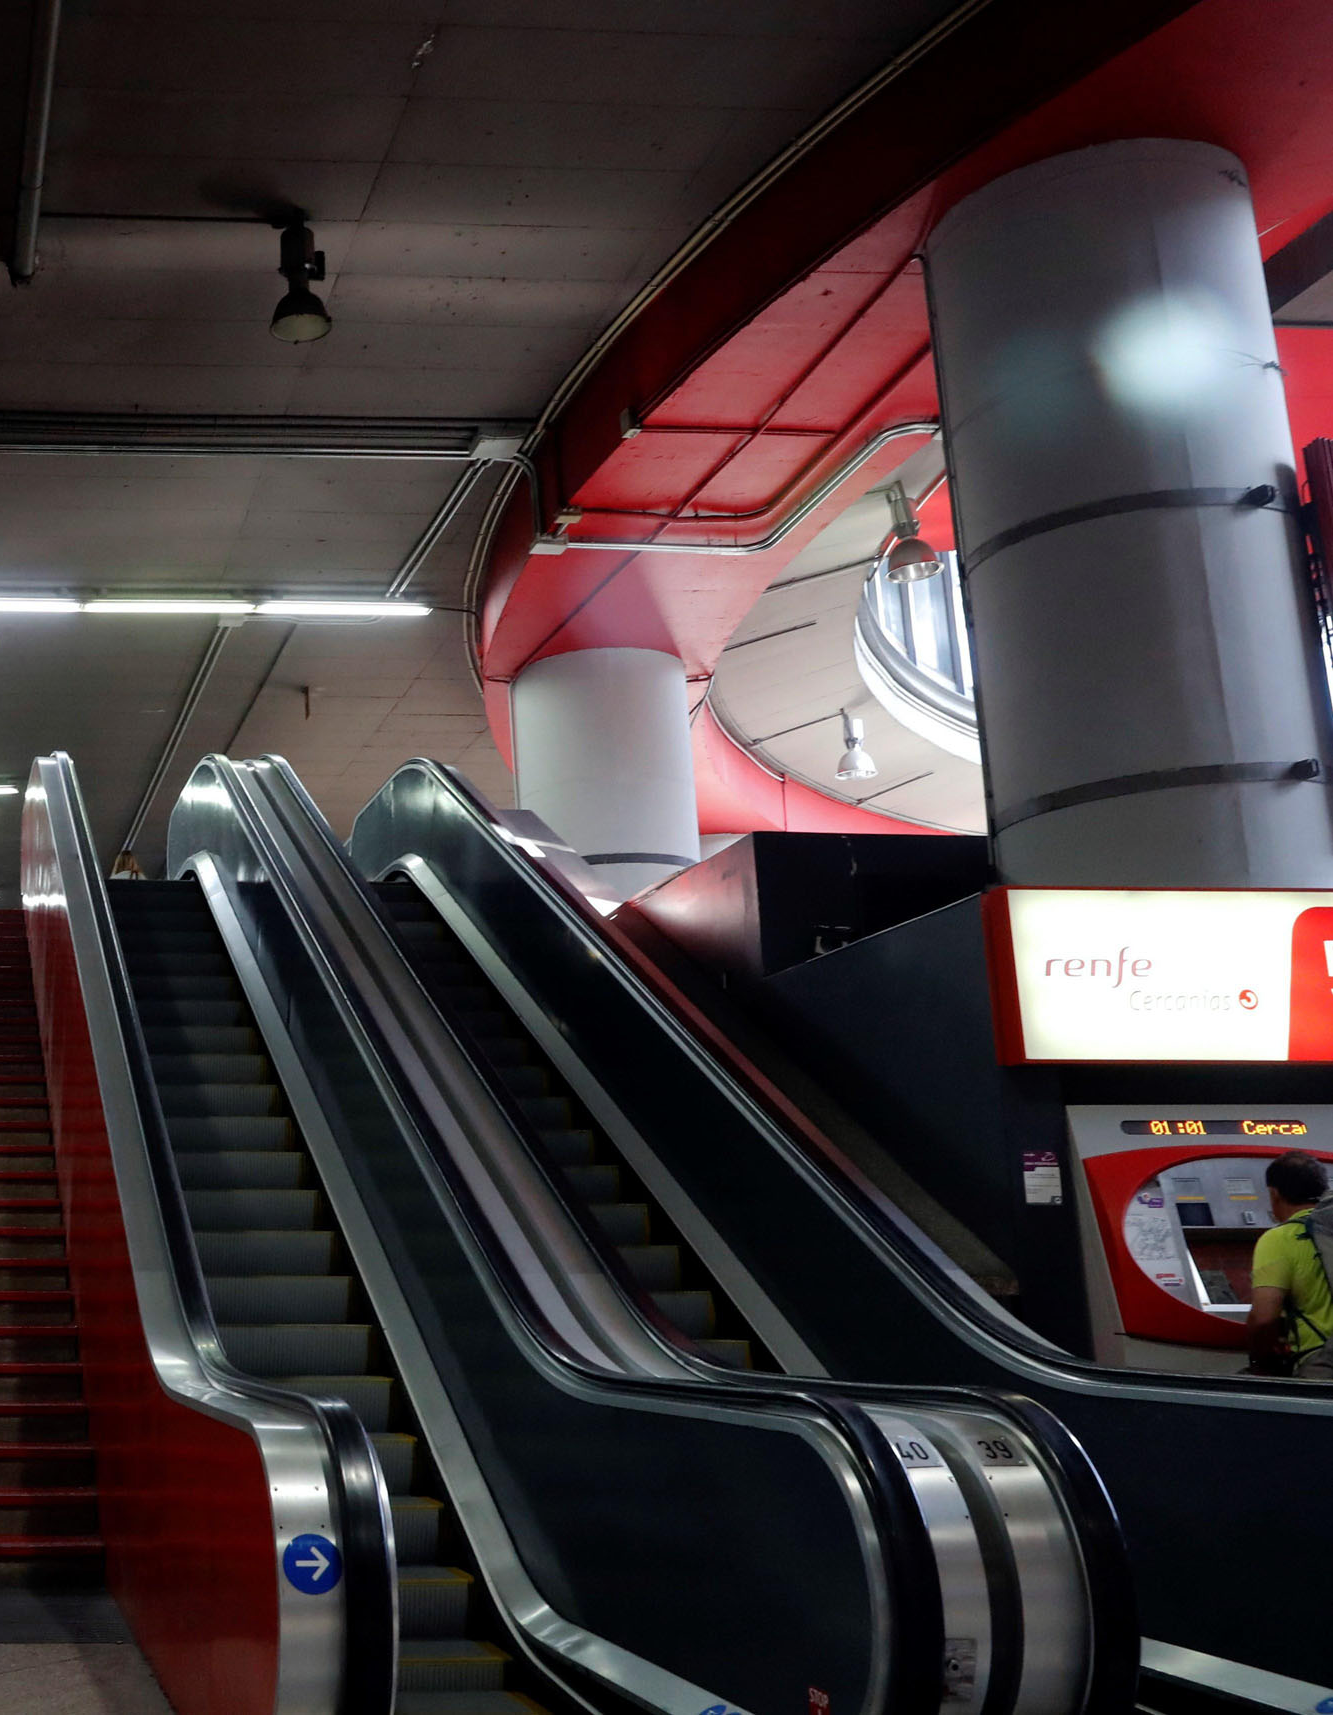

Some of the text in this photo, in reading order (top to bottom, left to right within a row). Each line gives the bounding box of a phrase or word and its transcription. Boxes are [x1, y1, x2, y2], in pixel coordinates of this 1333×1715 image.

[1045, 946, 1152, 988] renfe
[893, 1441, 929, 1460] 40
[977, 1441, 1013, 1459] 39
[808, 1687, 829, 1709] STOP
